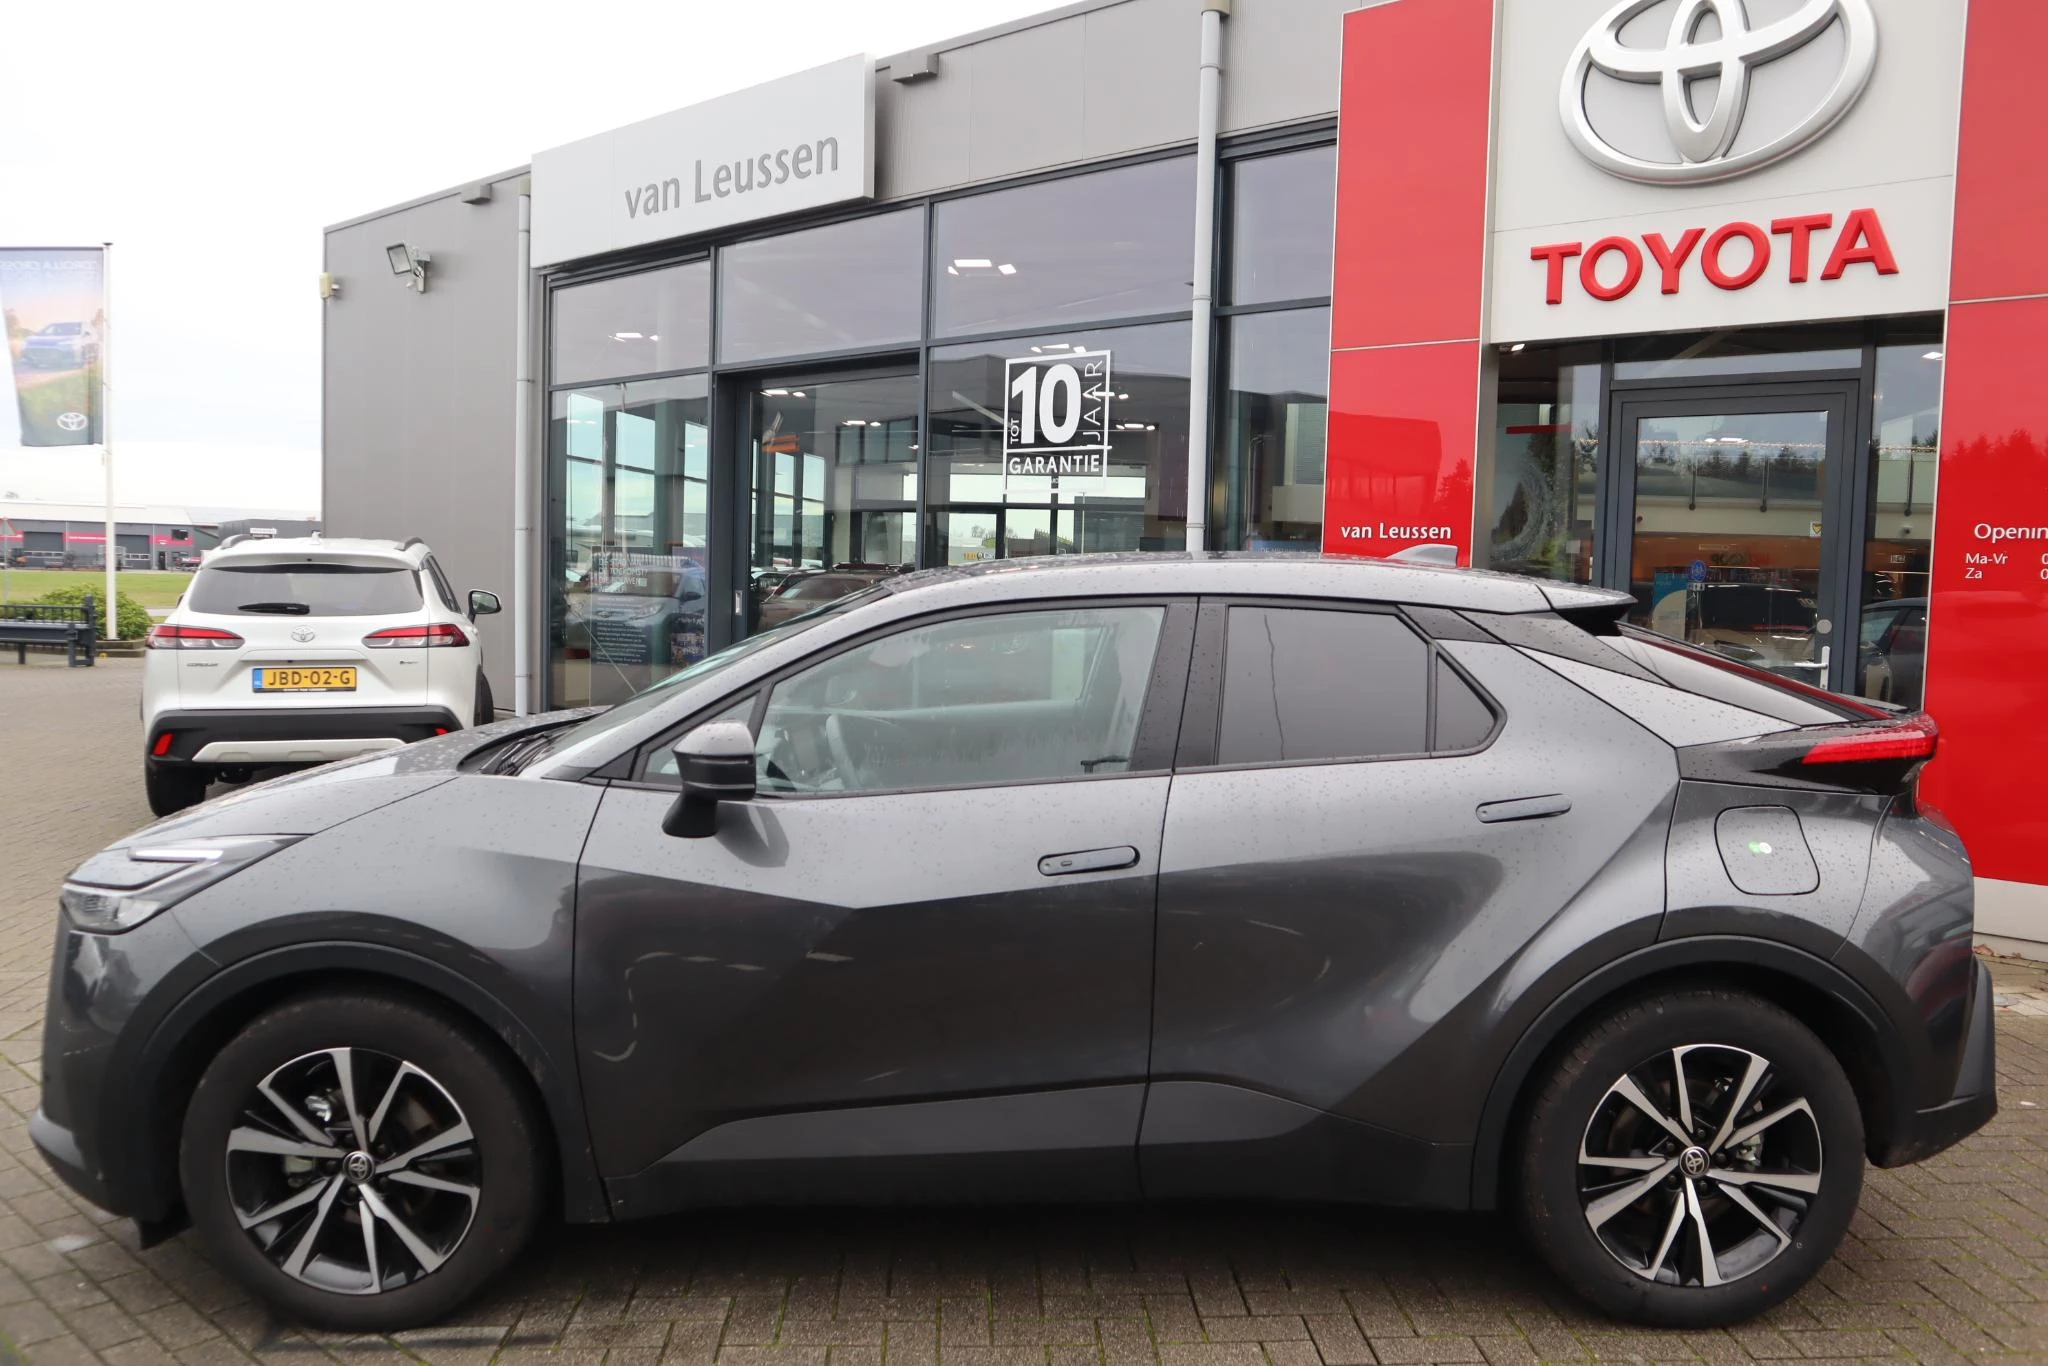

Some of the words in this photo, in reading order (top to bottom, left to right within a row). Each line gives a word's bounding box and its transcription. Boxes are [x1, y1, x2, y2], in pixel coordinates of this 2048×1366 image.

[624, 176, 680, 219] van
[694, 136, 839, 204] Leussen
[1530, 207, 1899, 305] TOYOTA
[1011, 363, 1081, 444] 10
[1083, 360, 1102, 442] JAAR
[1010, 417, 1020, 445] TOT
[1009, 454, 1100, 474] GARANTIE
[1340, 526, 1372, 539] van
[1379, 522, 1452, 539] Leussen
[1965, 552, 2009, 565] Ma-Vr
[1964, 567, 1983, 579] Za
[268, 671, 350, 686] JBD-02-G
